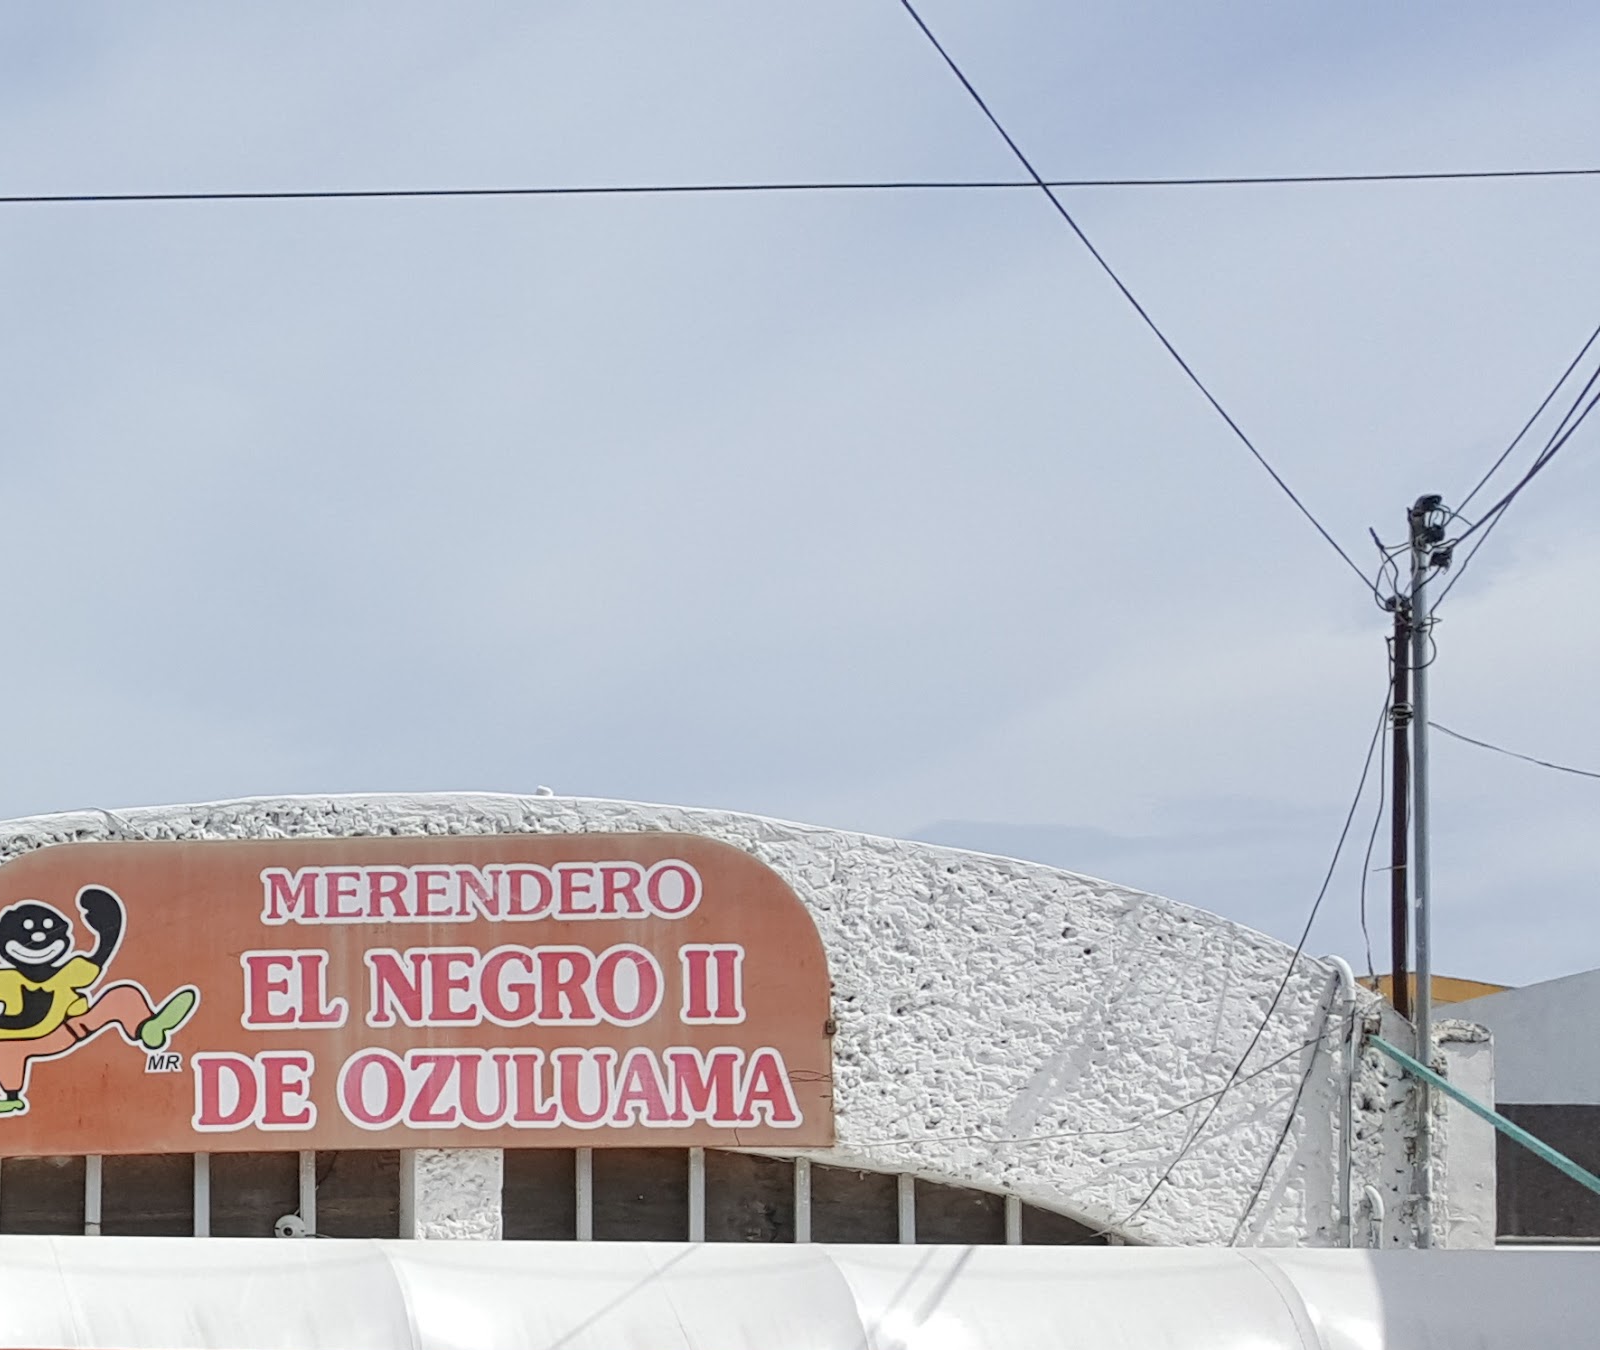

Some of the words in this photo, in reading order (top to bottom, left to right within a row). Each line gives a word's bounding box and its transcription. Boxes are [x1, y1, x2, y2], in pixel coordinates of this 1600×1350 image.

[264, 865, 698, 922] MERENDERO
[244, 953, 345, 1026] EL
[368, 947, 661, 1026] NEGRO
[682, 947, 743, 1021] II
[146, 1053, 181, 1071] MR
[195, 1053, 314, 1128] DE
[341, 1050, 799, 1126] OZULUAMA
